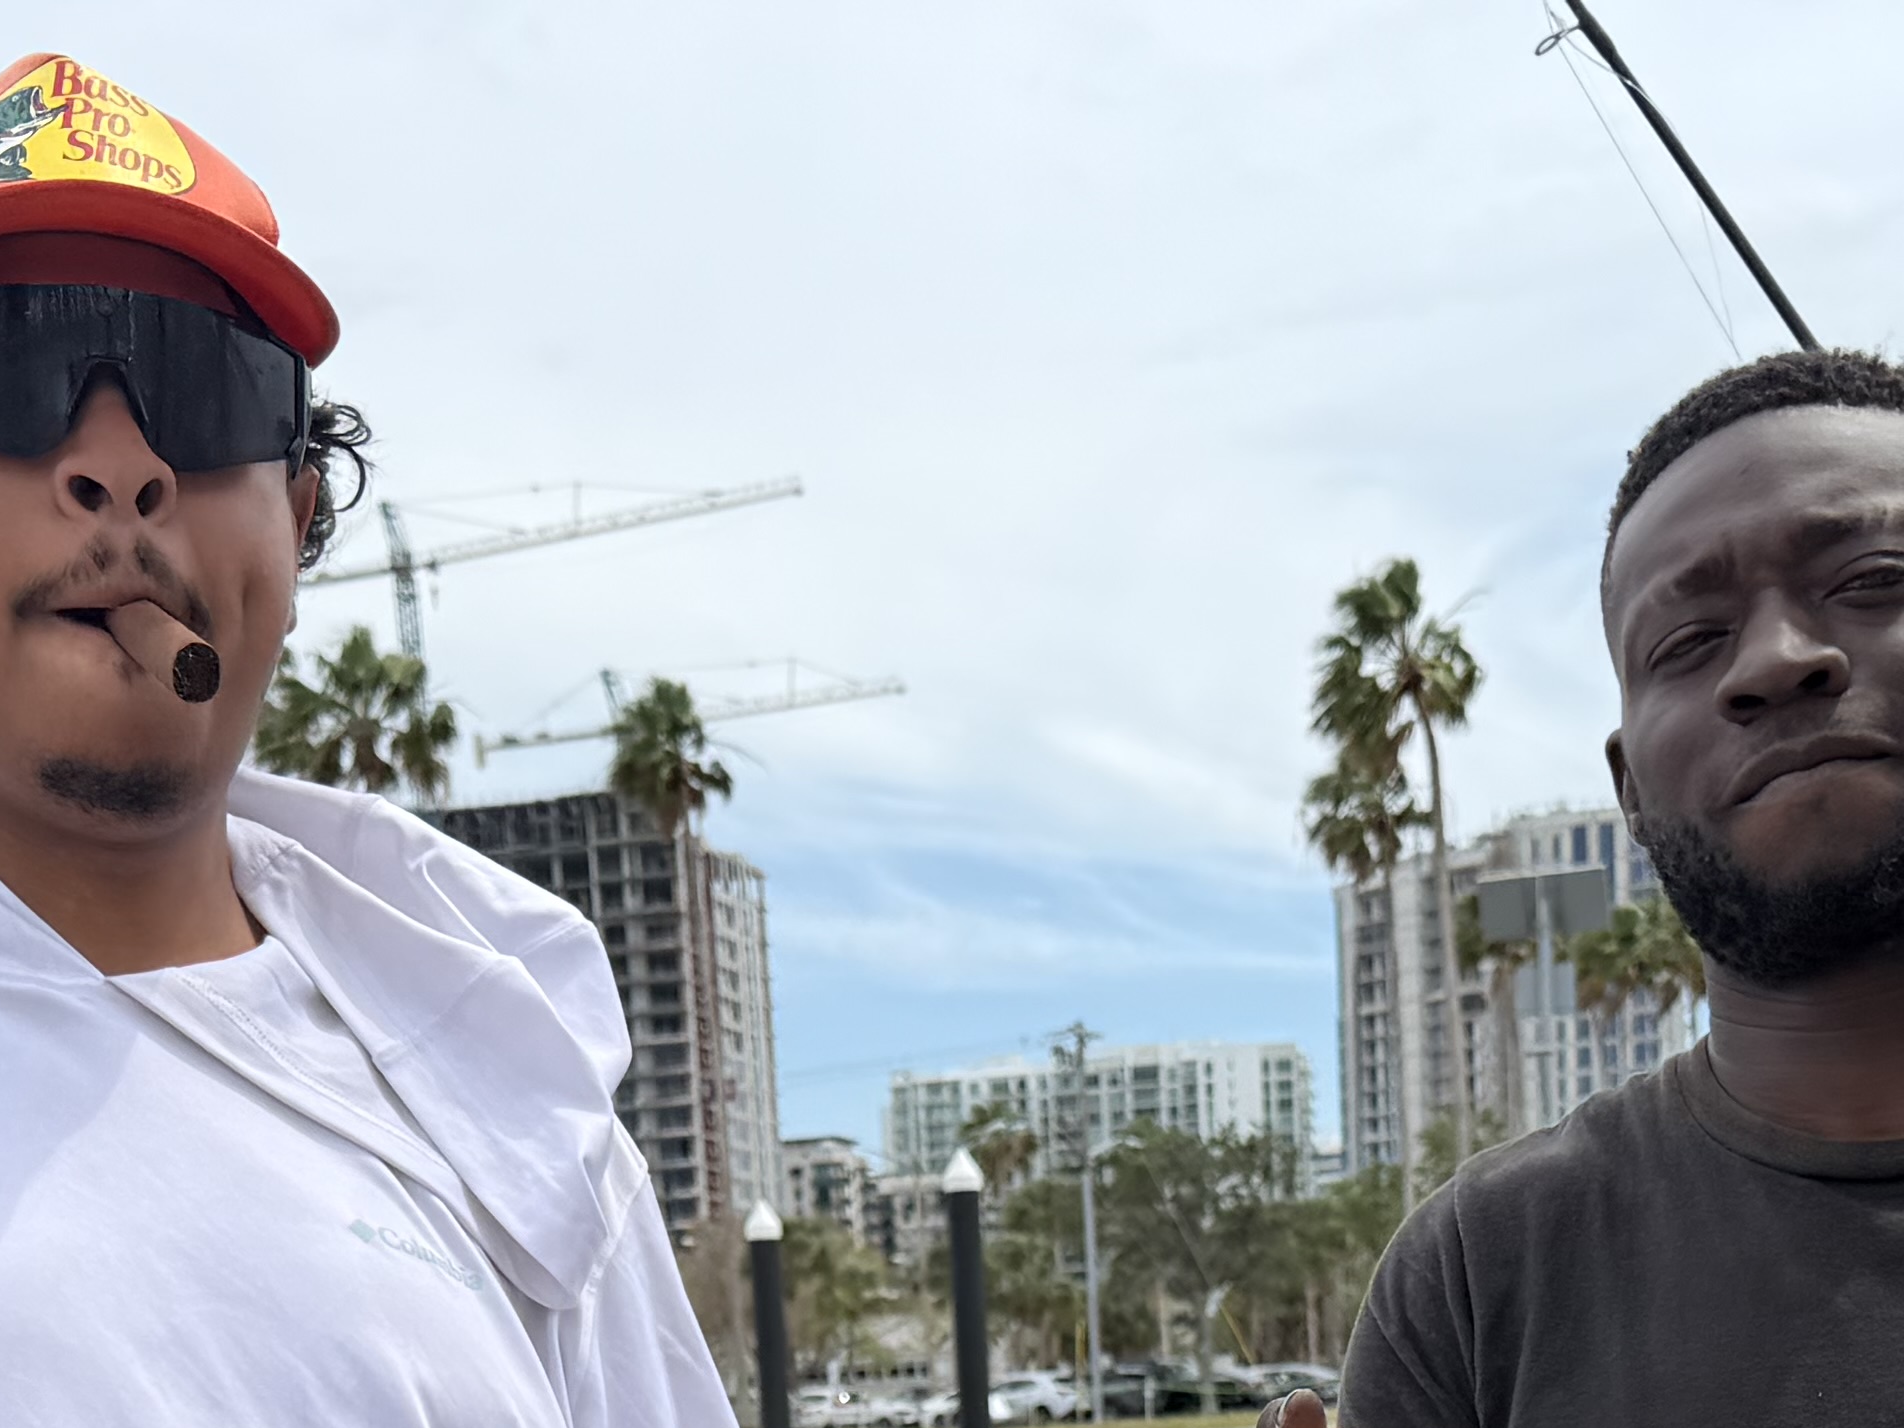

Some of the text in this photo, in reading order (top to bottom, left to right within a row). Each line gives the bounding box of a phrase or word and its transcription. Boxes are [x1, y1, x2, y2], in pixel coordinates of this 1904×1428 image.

[51, 60, 149, 117] Bass
[60, 97, 131, 137] Pro
[62, 129, 182, 190] Shops
